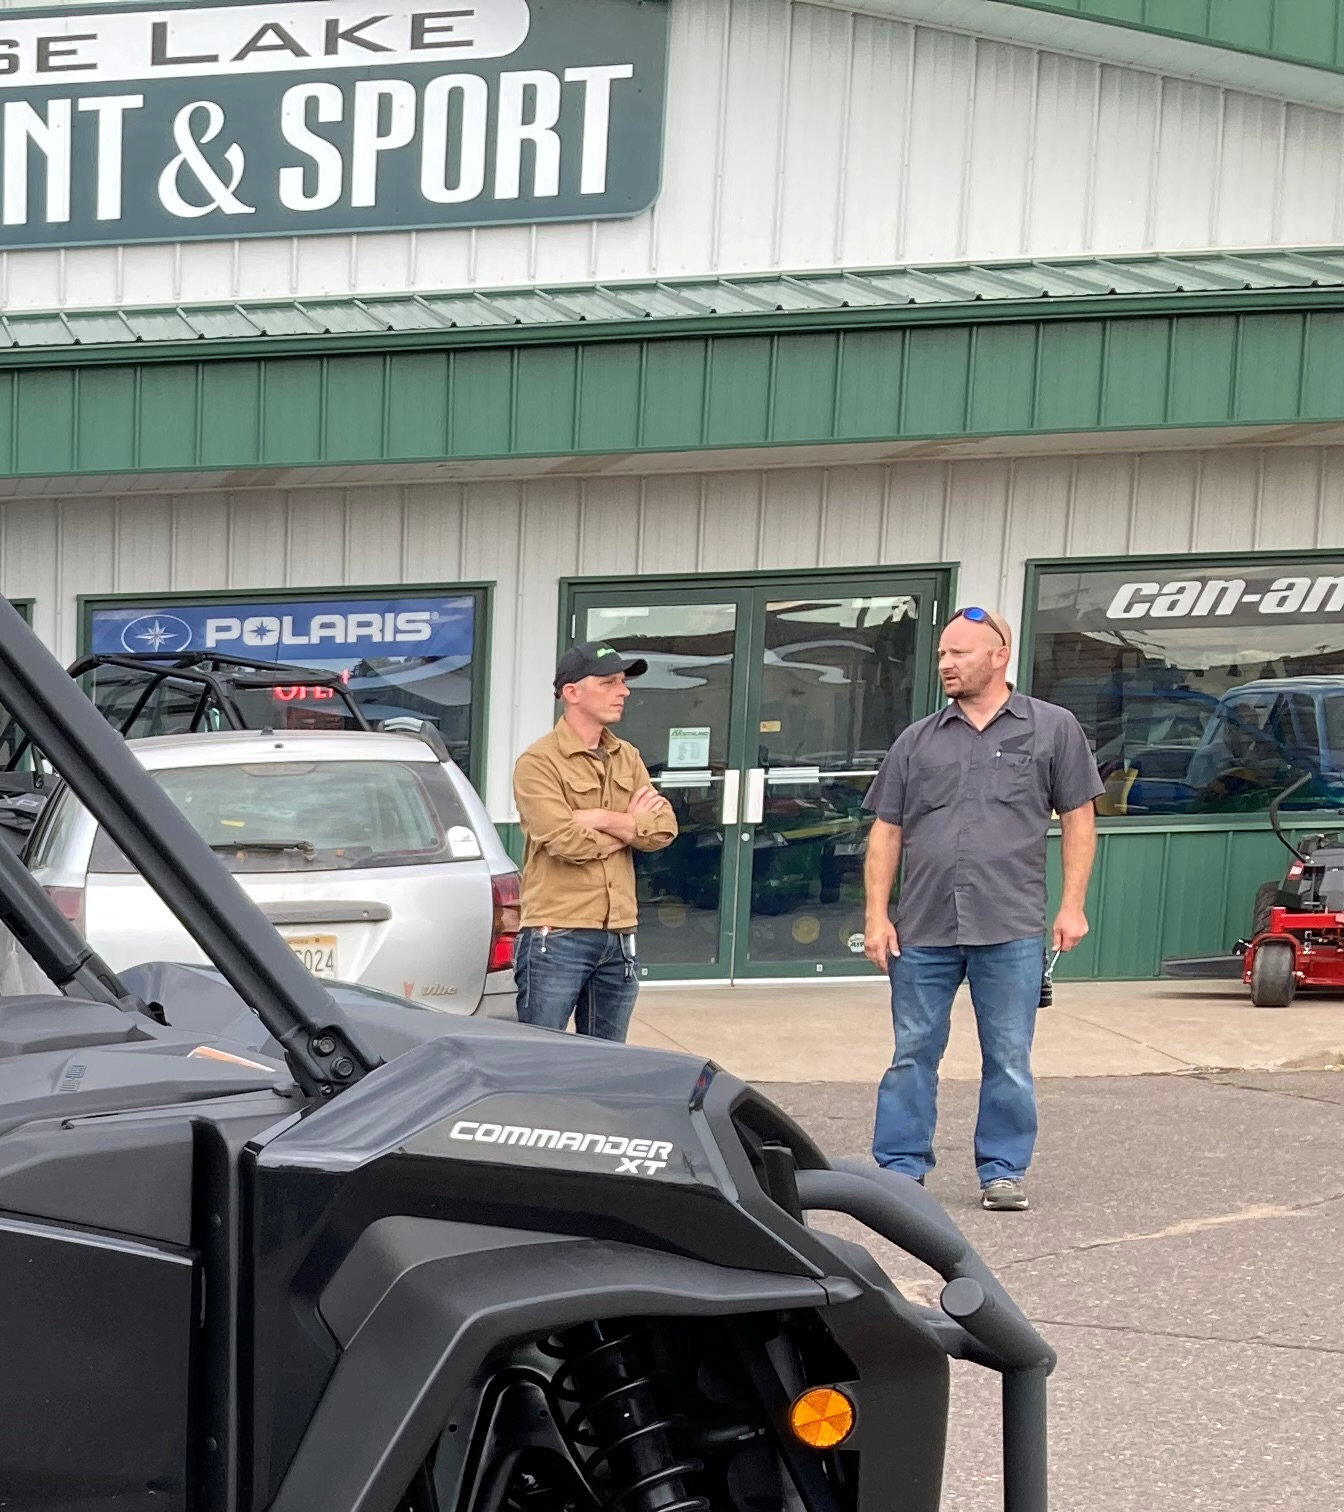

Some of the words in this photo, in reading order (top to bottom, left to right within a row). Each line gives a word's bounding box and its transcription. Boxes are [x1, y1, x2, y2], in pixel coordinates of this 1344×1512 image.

[153, 10, 476, 65] LAKE
[158, 101, 255, 217] &
[279, 64, 633, 213] SPORT
[206, 611, 432, 648] POLARIS
[450, 1120, 675, 1160] COMMANDER
[615, 1158, 668, 1175] XT
